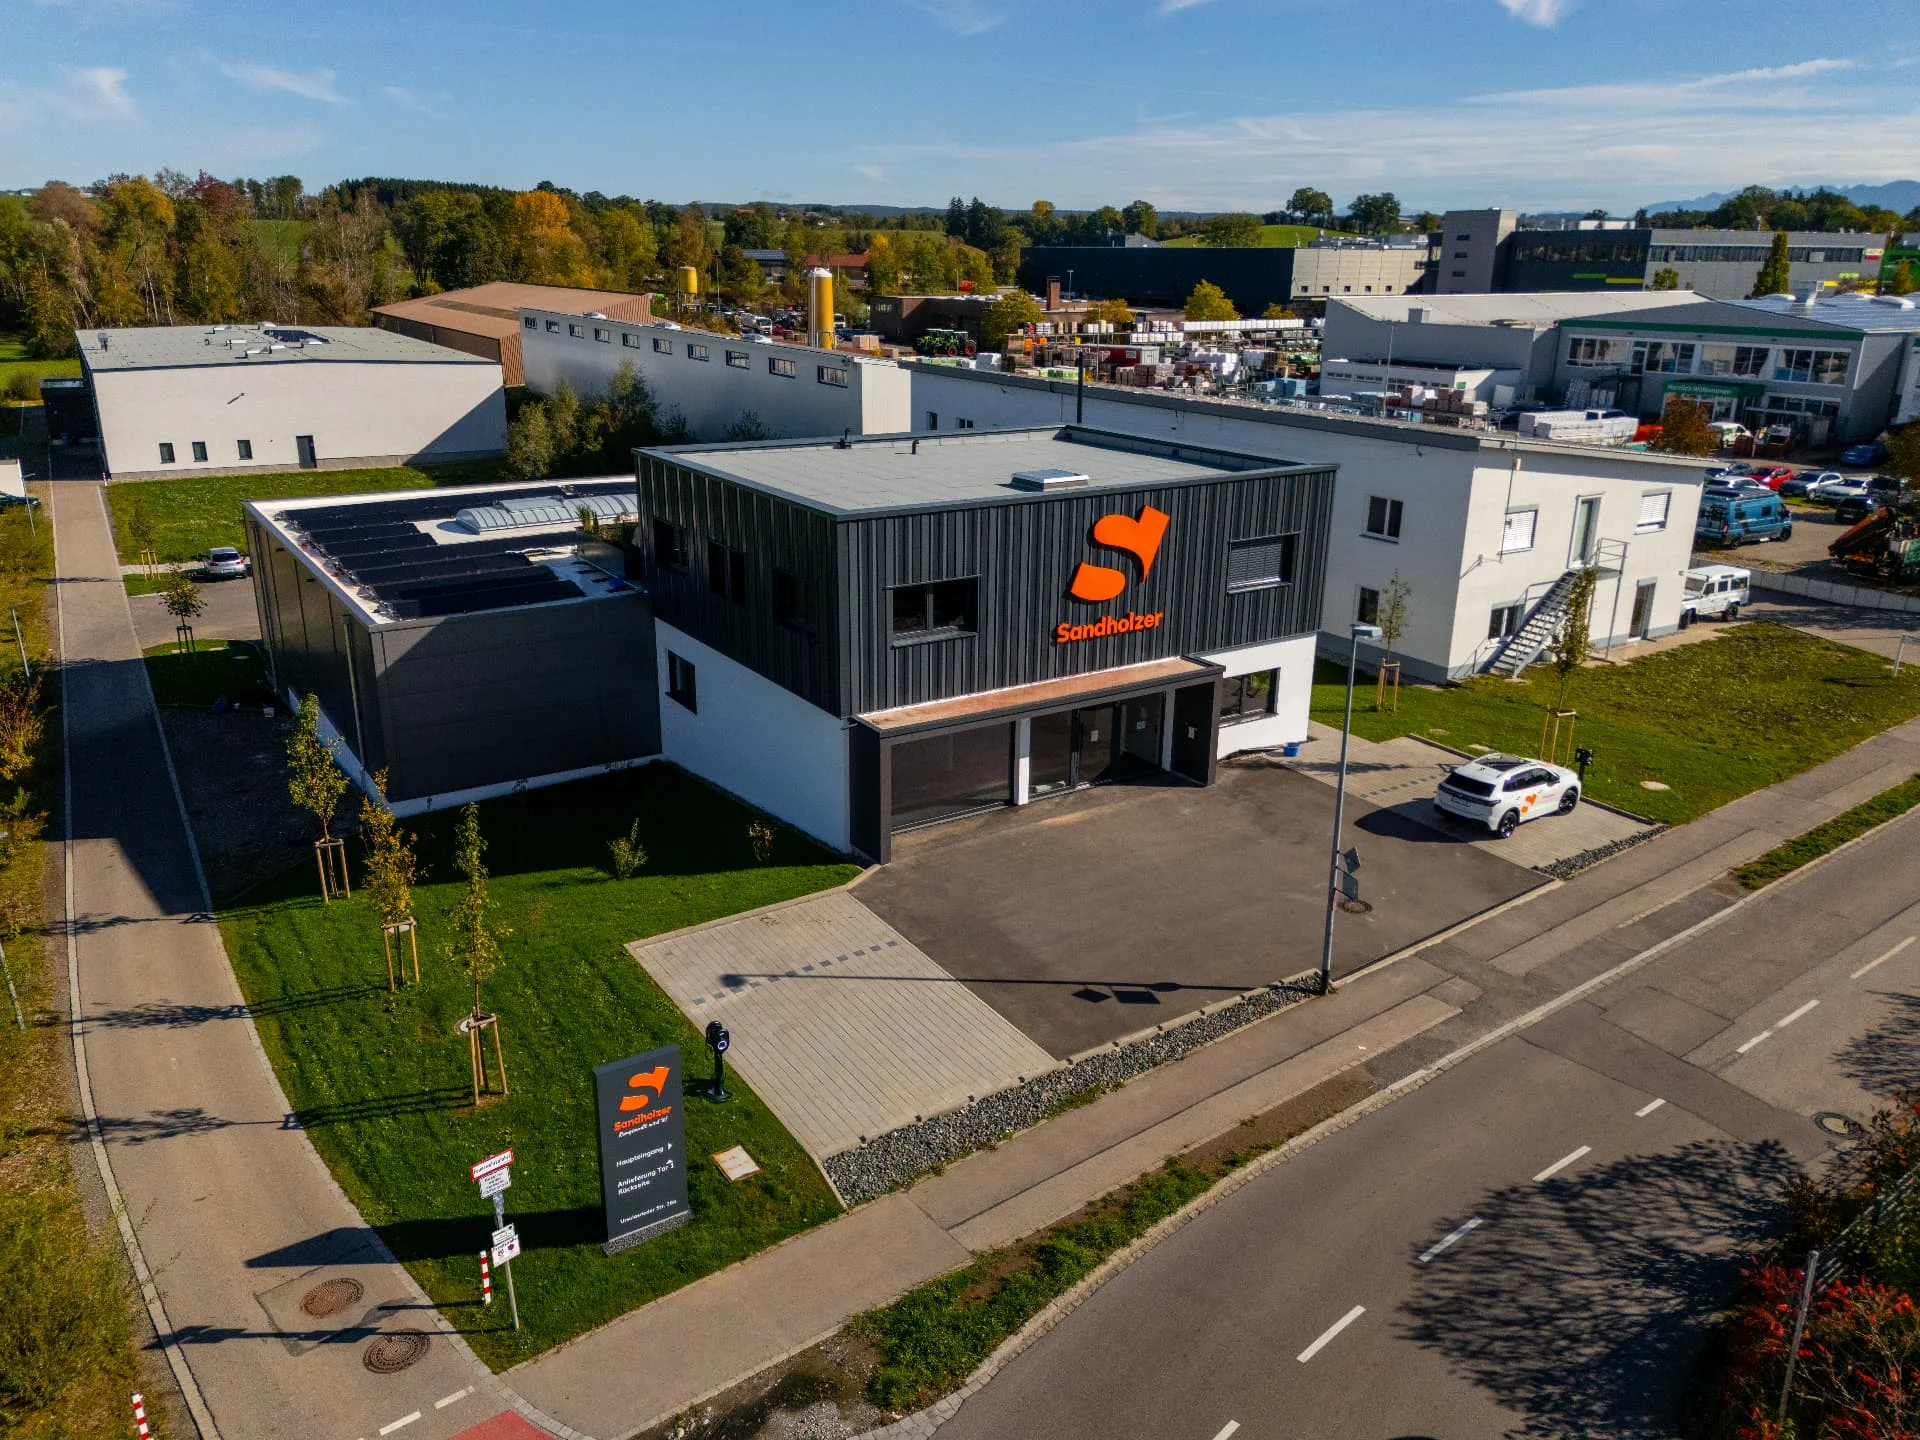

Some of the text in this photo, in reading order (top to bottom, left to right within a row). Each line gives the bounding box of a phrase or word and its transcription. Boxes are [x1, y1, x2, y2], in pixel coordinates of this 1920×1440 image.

[1057, 611, 1163, 644] Sandholzer
[613, 1106, 672, 1132] Sandholzer
[616, 1146, 664, 1168] Haupteingang
[617, 1170, 656, 1188] Anlieferung
[656, 1165, 669, 1174] Tor
[617, 1180, 650, 1196] Rückseite
[655, 1203, 666, 1211] Str.
